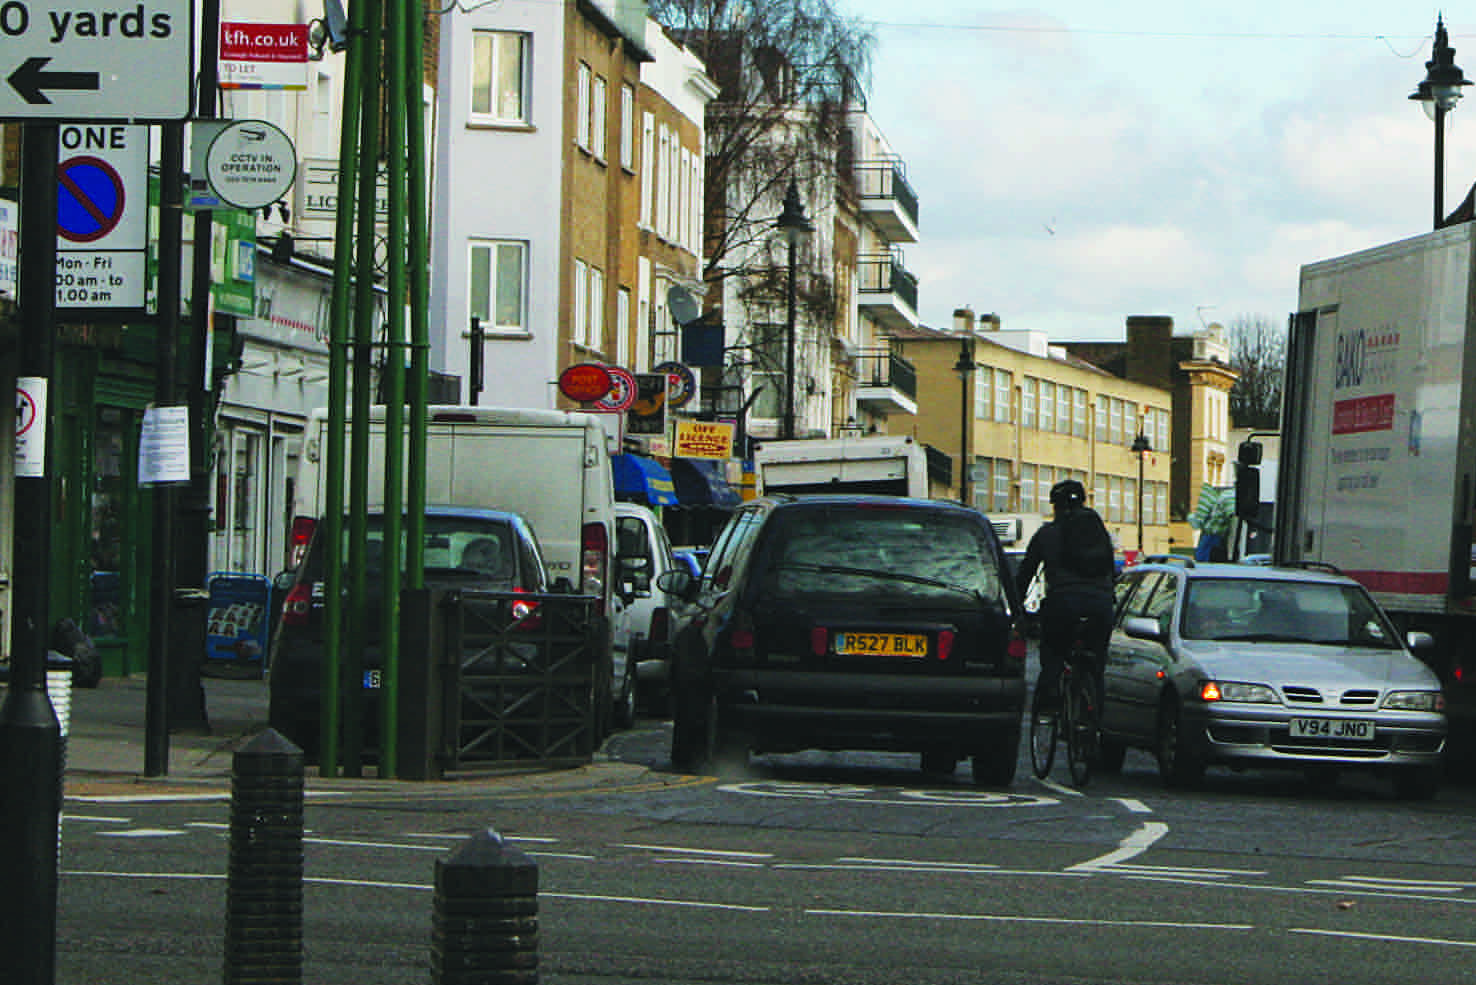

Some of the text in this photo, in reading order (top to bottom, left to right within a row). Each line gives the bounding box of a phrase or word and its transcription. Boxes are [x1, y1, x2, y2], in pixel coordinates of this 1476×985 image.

[48, 3, 172, 43] yards
[61, 127, 127, 149] ONE
[221, 163, 281, 173] OPERATION
[94, 256, 112, 269] Fri
[77, 276, 97, 287] am
[109, 273, 124, 287] to
[91, 291, 112, 302] am
[846, 635, 927, 653] R527 BLK
[1298, 719, 1330, 735] V94
